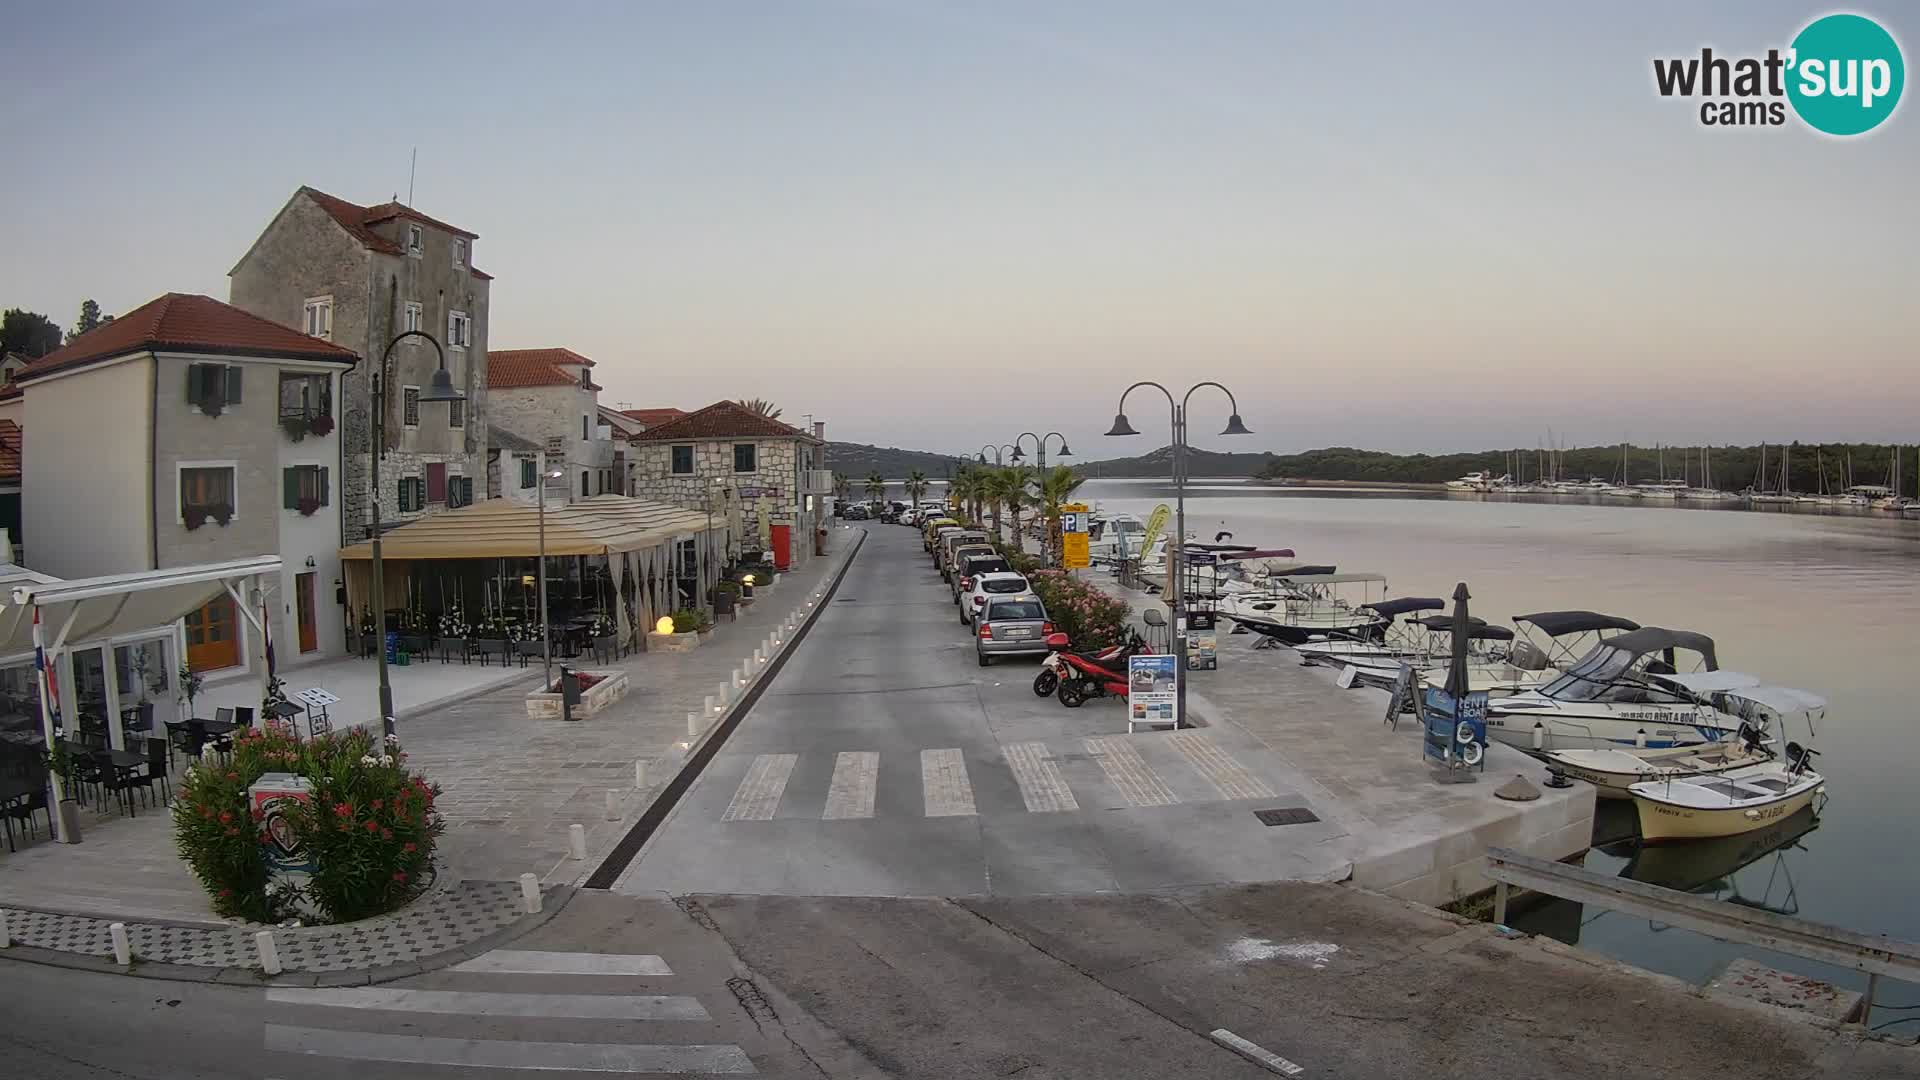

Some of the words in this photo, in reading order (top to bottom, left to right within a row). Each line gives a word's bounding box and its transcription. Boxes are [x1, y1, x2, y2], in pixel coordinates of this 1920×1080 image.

[1066, 515, 1075, 530] P
[1654, 712, 1673, 721] RENT
[1674, 713, 1679, 721] A
[1680, 712, 1698, 724] BOAT
